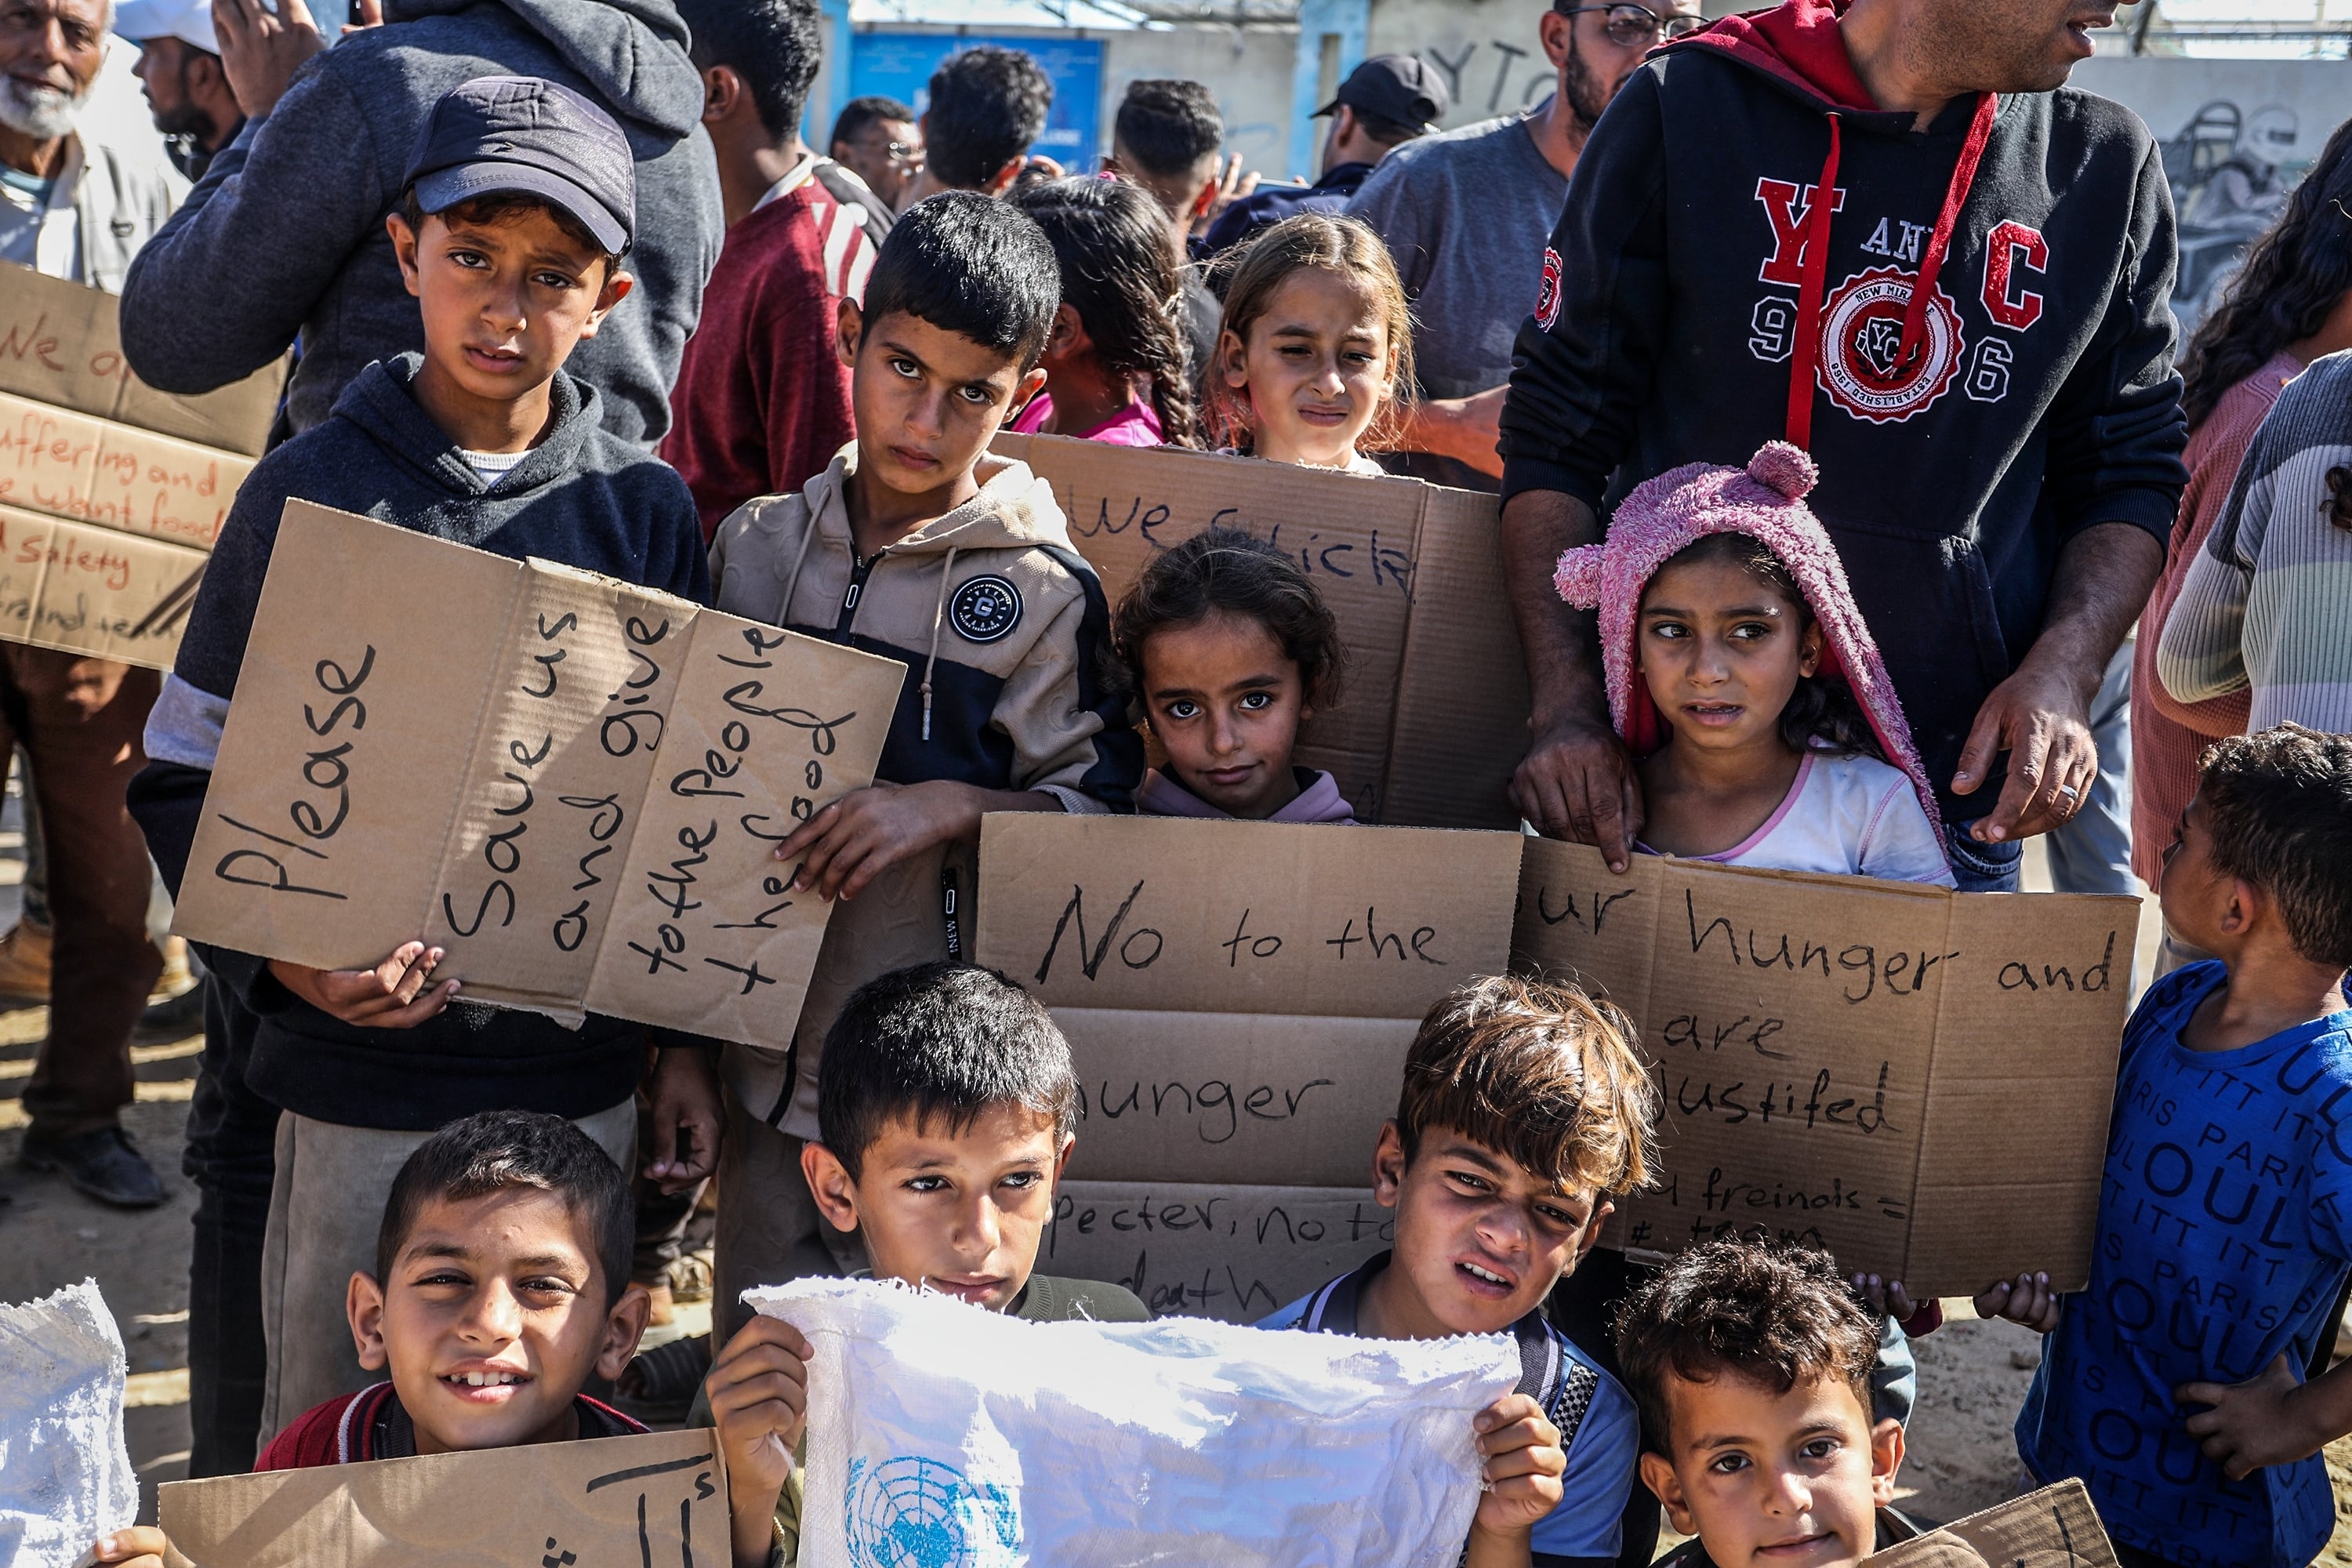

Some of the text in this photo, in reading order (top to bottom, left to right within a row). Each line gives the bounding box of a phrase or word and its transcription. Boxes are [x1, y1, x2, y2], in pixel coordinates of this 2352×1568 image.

[1855, 285, 1882, 303] NEW
[1860, 216, 1950, 264] AN
[1980, 219, 2050, 333] C
[1964, 336, 2014, 404] 6
[0, 410, 219, 497] uffering and
[33, 483, 132, 528] want
[151, 488, 225, 544] food
[1069, 485, 1171, 549] We
[522, 612, 577, 699] us
[553, 616, 669, 952] and give
[704, 862, 804, 995] the
[1034, 880, 1448, 984] No to the
[1537, 886, 1637, 936] ur
[1685, 888, 1960, 1004] hunger
[1998, 931, 2115, 993] and
[1663, 1014, 1791, 1061] are
[2124, 1073, 2176, 1127] ARIS
[2198, 1122, 2305, 1190] PARI
[1050, 1194, 1237, 1258] pecter,
[2153, 1258, 2280, 1330] PARIS
